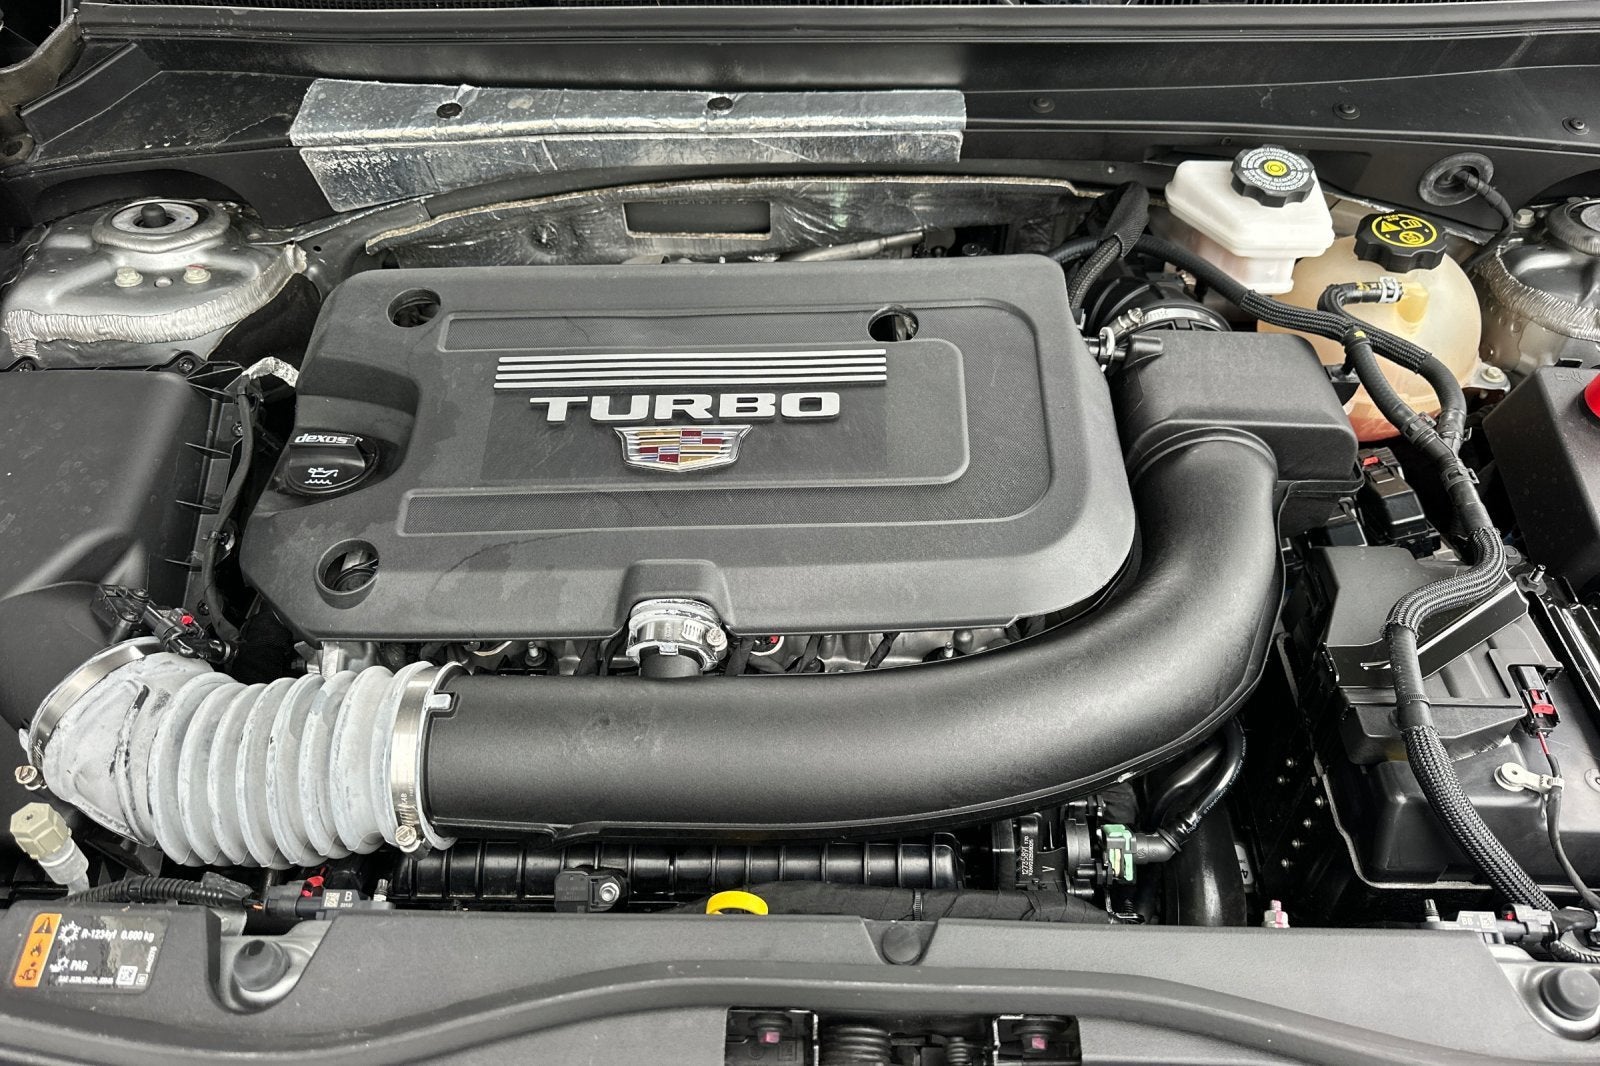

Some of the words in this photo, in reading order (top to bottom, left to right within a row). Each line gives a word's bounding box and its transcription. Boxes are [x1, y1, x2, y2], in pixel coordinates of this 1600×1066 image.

[529, 391, 840, 422] TURBO
[294, 433, 352, 444] dexos
[344, 890, 353, 902] B
[69, 959, 89, 972] PAG
